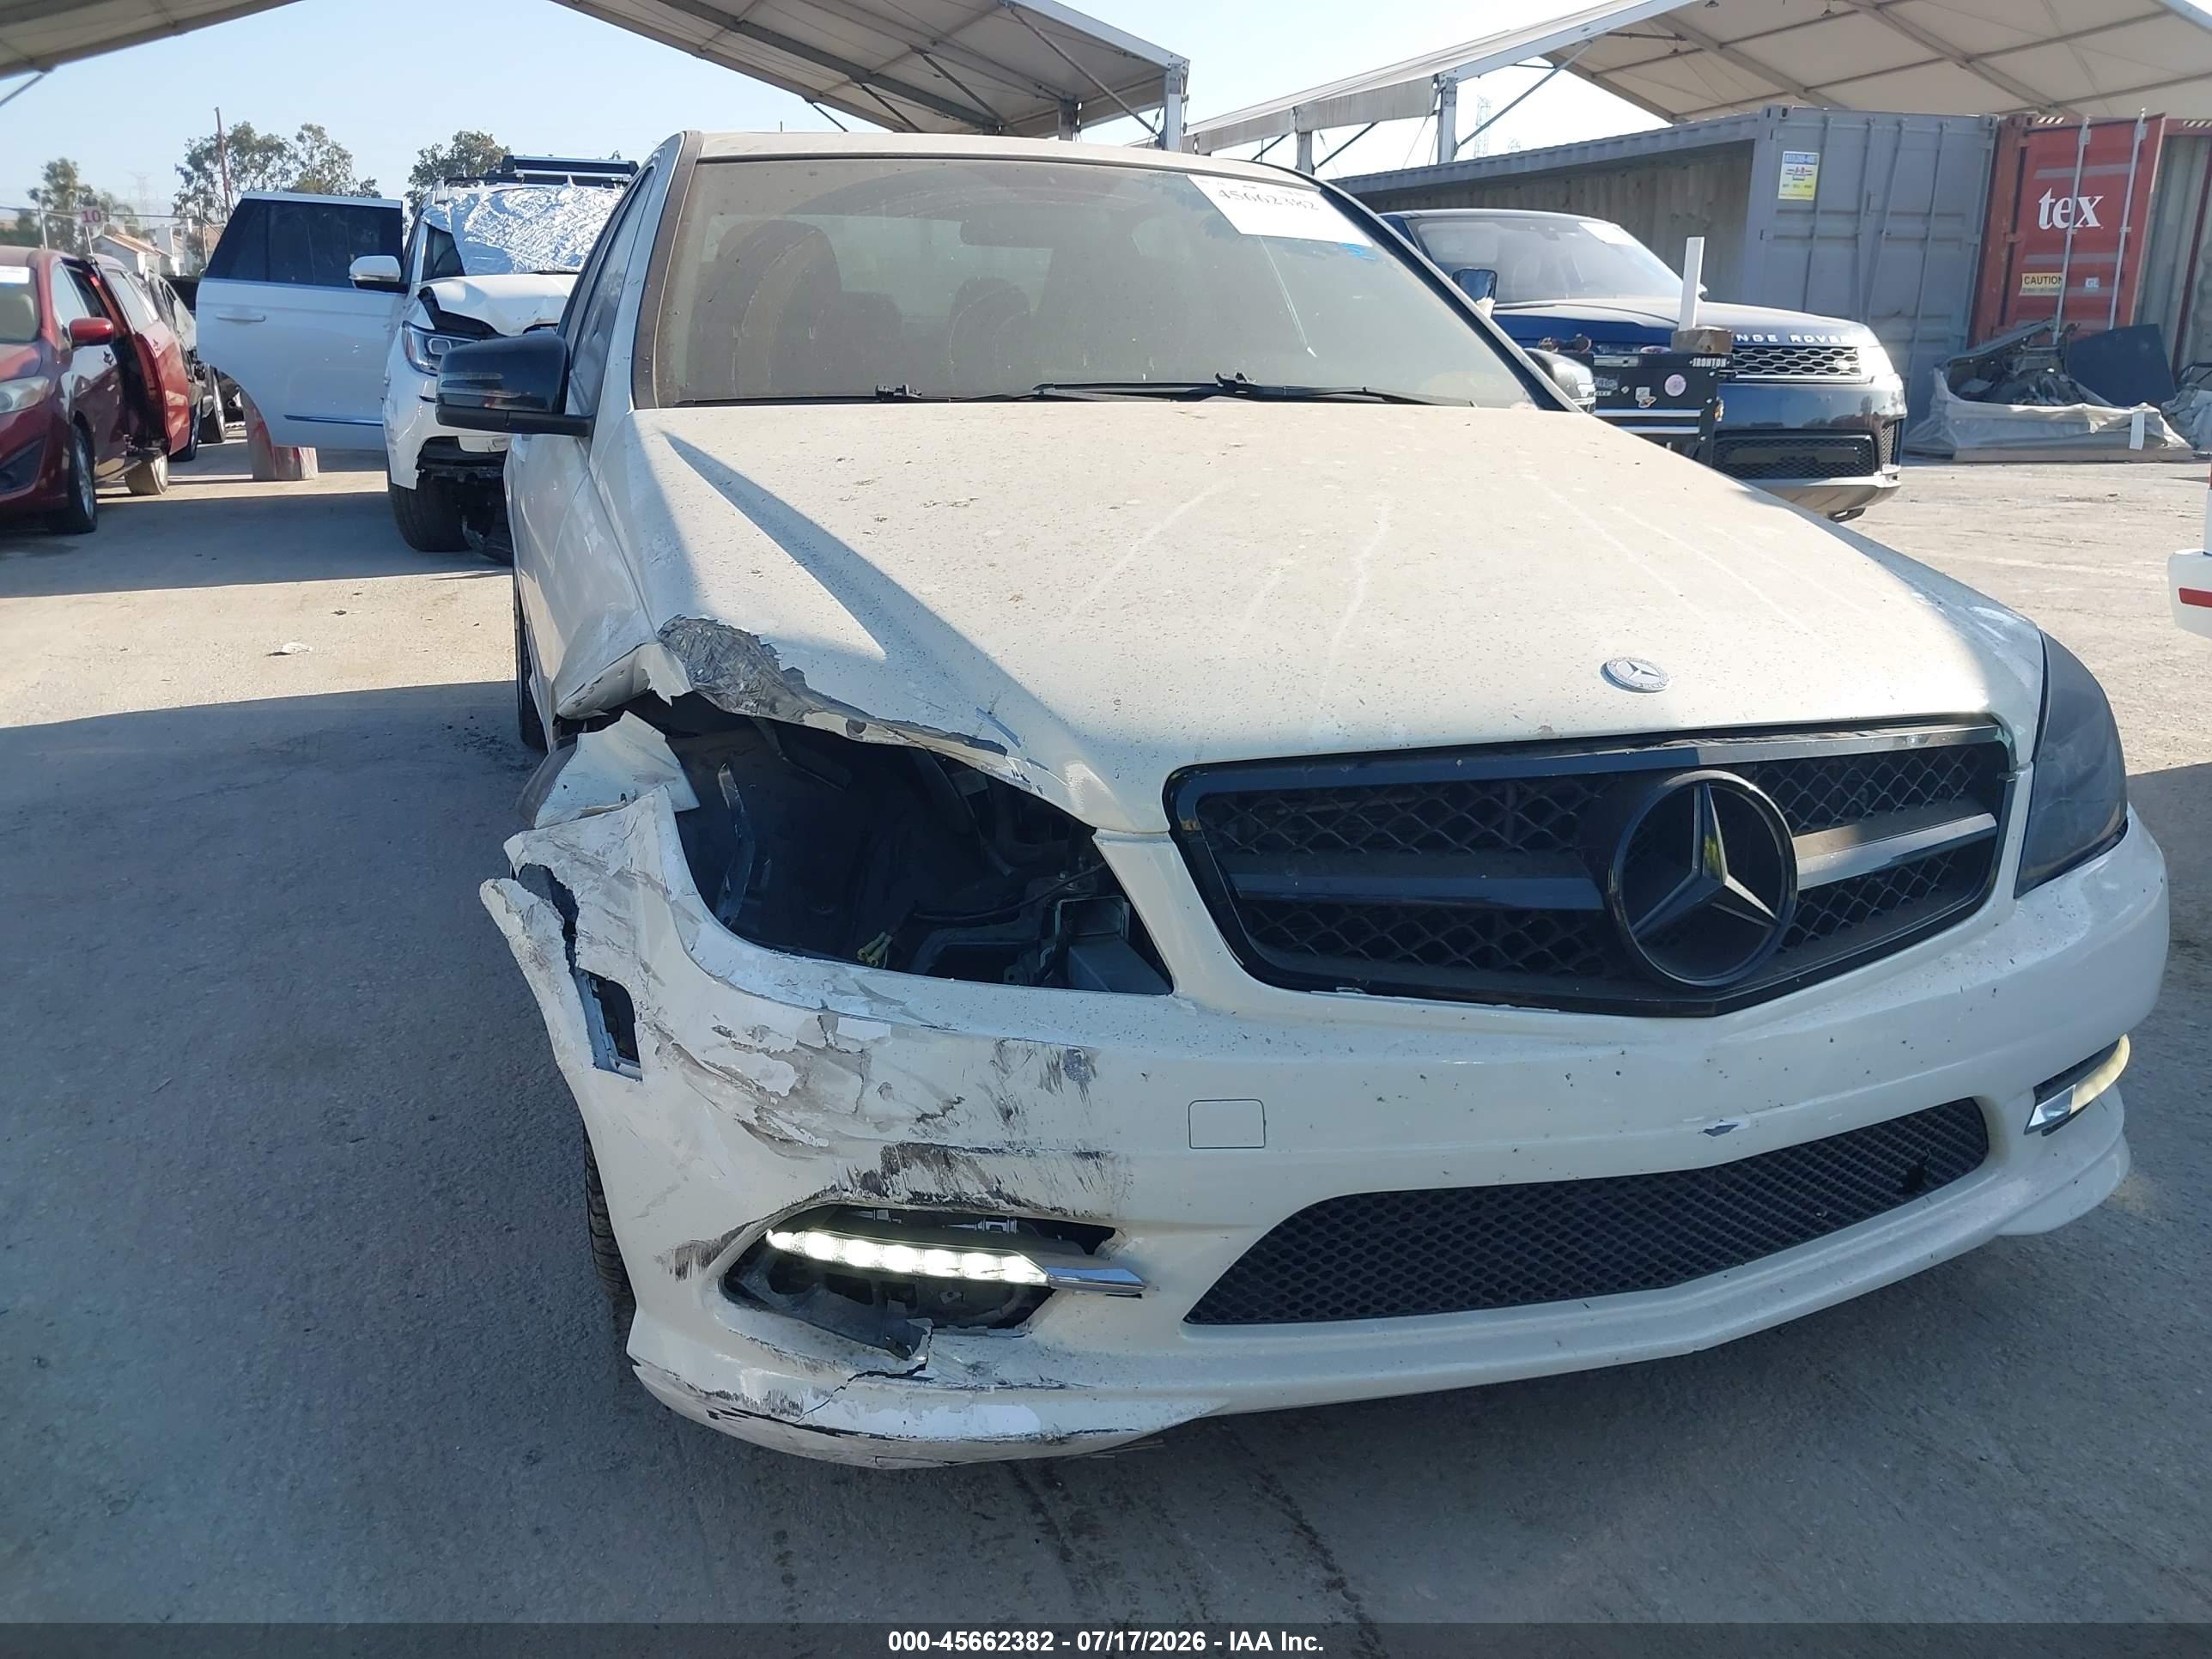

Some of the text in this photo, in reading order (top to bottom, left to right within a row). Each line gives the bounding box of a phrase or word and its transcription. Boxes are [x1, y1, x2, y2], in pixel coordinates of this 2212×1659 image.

[2039, 187, 2104, 230] tex
[82, 210, 101, 223] 10
[1735, 334, 1778, 343] NGE
